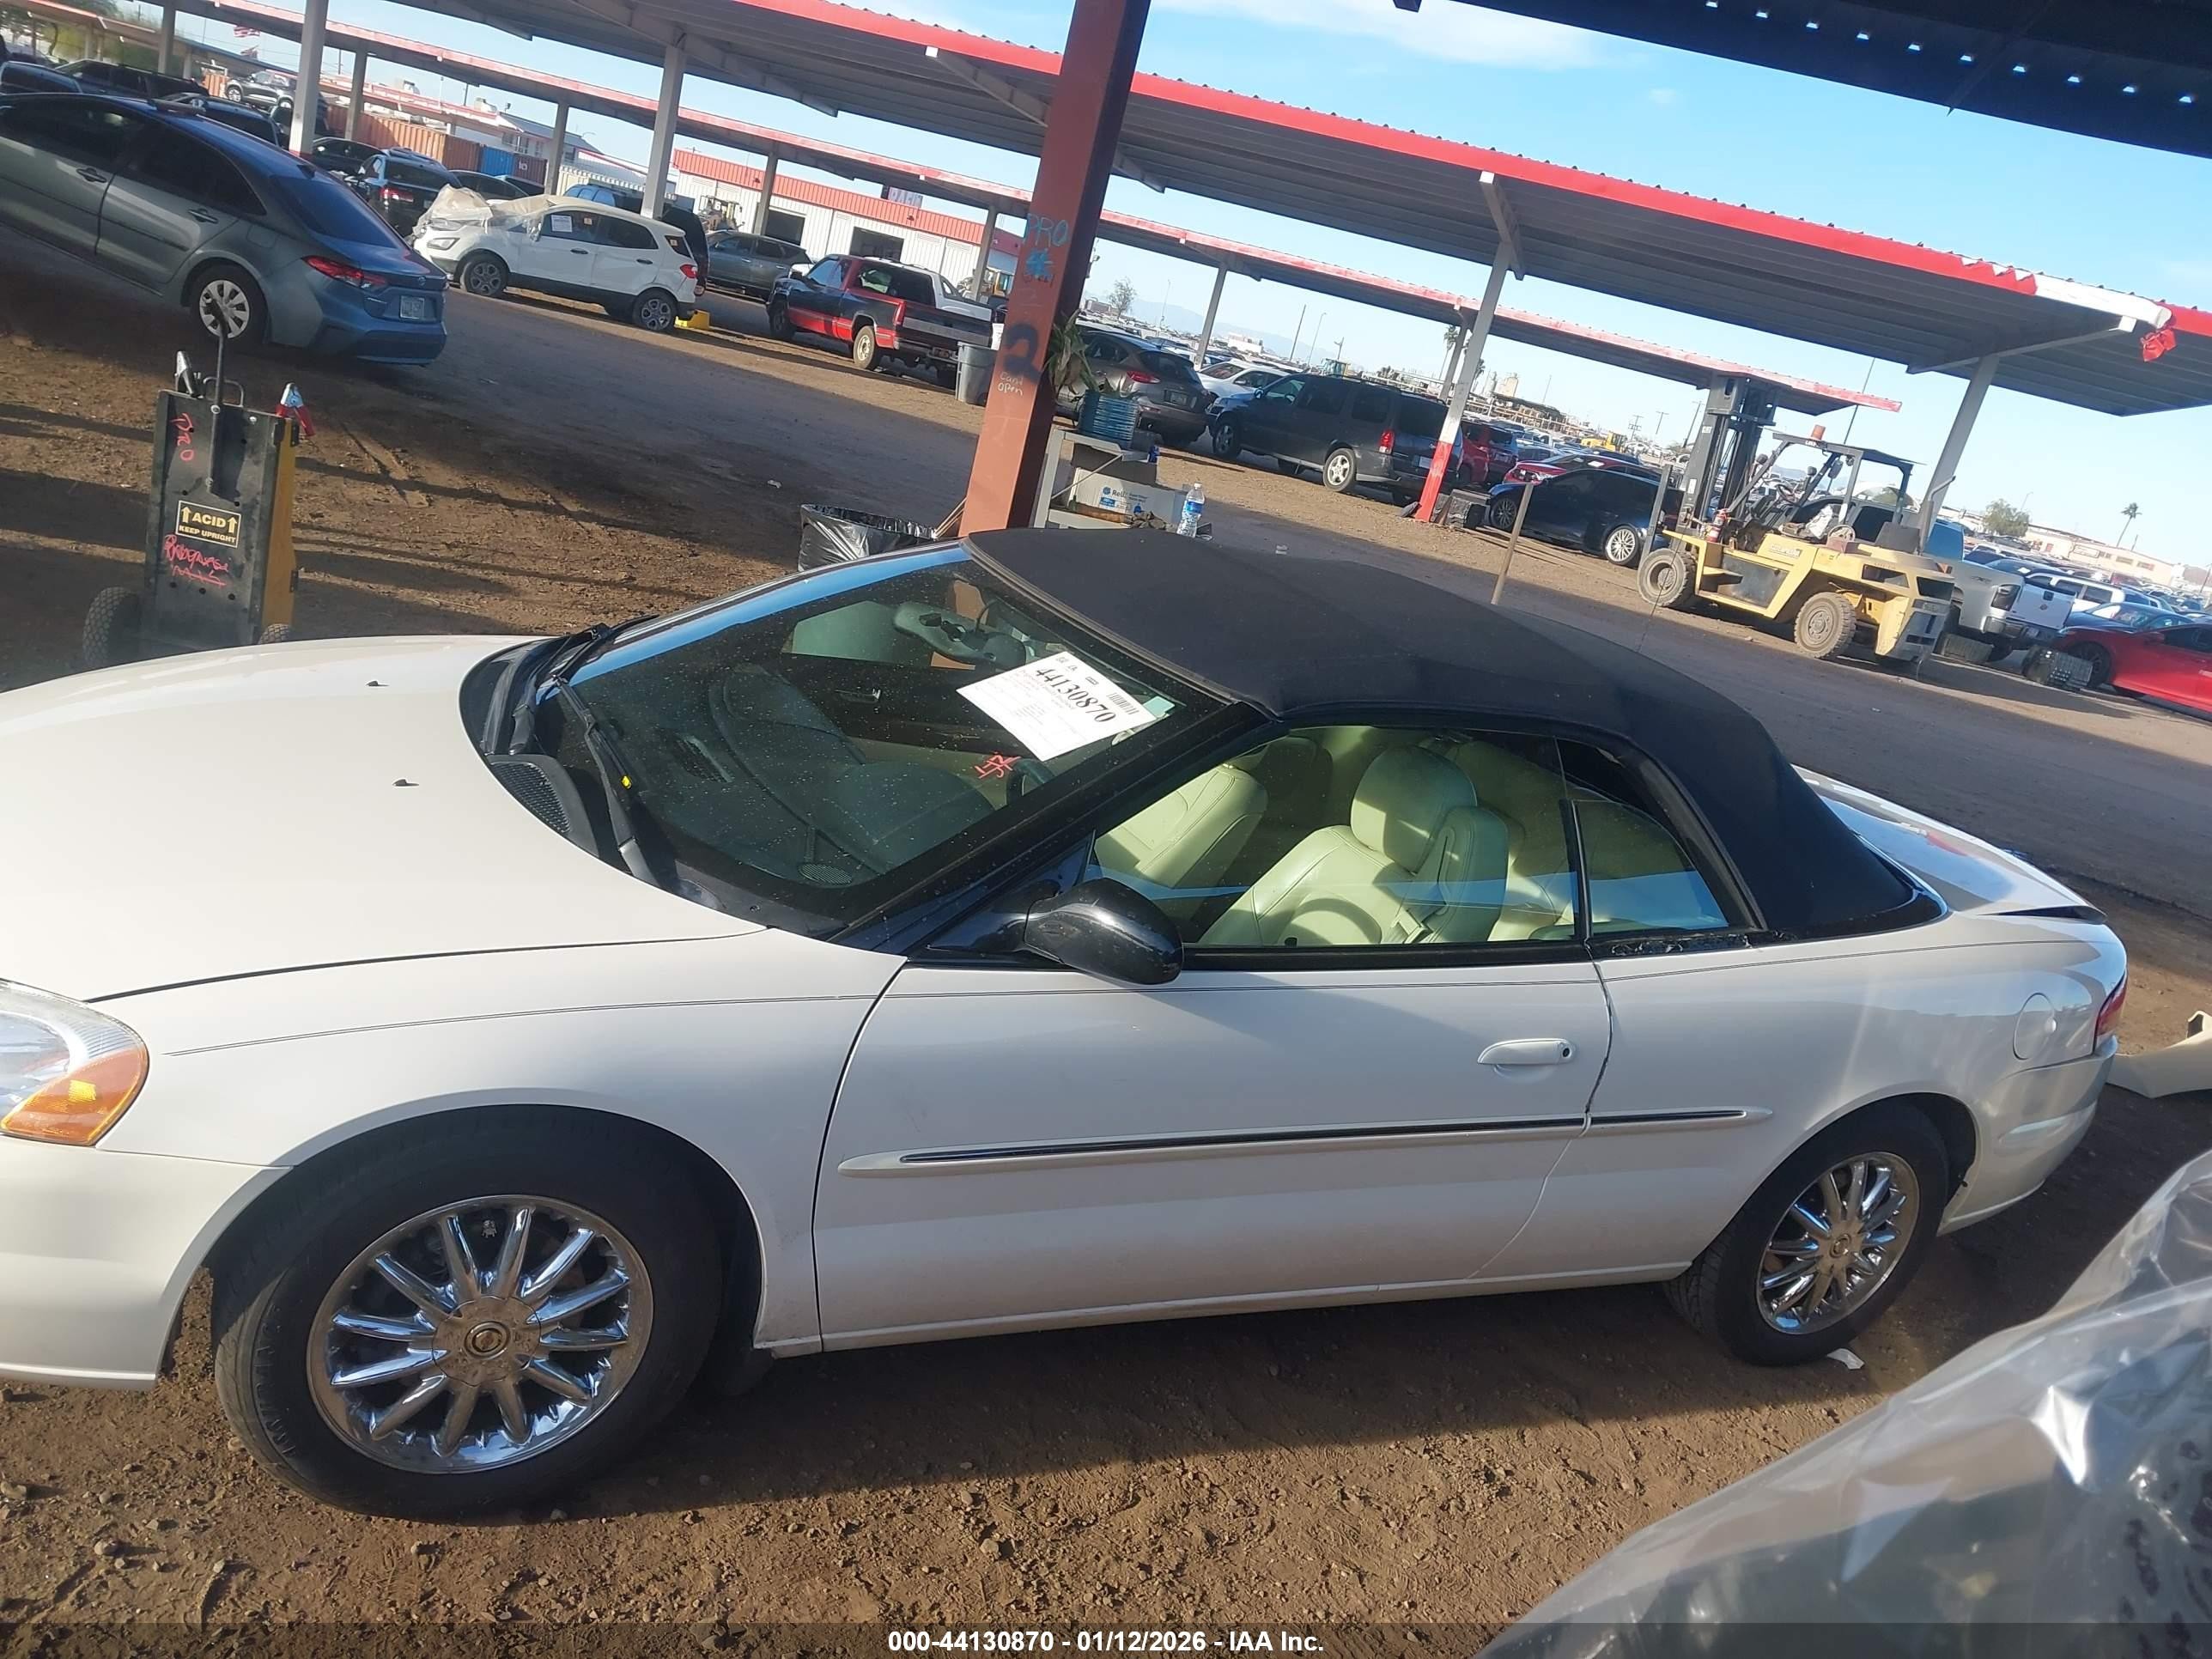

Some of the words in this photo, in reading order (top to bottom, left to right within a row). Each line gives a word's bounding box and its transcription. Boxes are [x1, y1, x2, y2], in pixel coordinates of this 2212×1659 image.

[1023, 213, 1069, 247] PRO
[1003, 323, 1042, 384] 2
[179, 525, 200, 536] KEEP
[201, 530, 236, 544] UPRIGHT
[191, 513, 227, 528] ACID
[1036, 669, 1116, 722] 44130870
